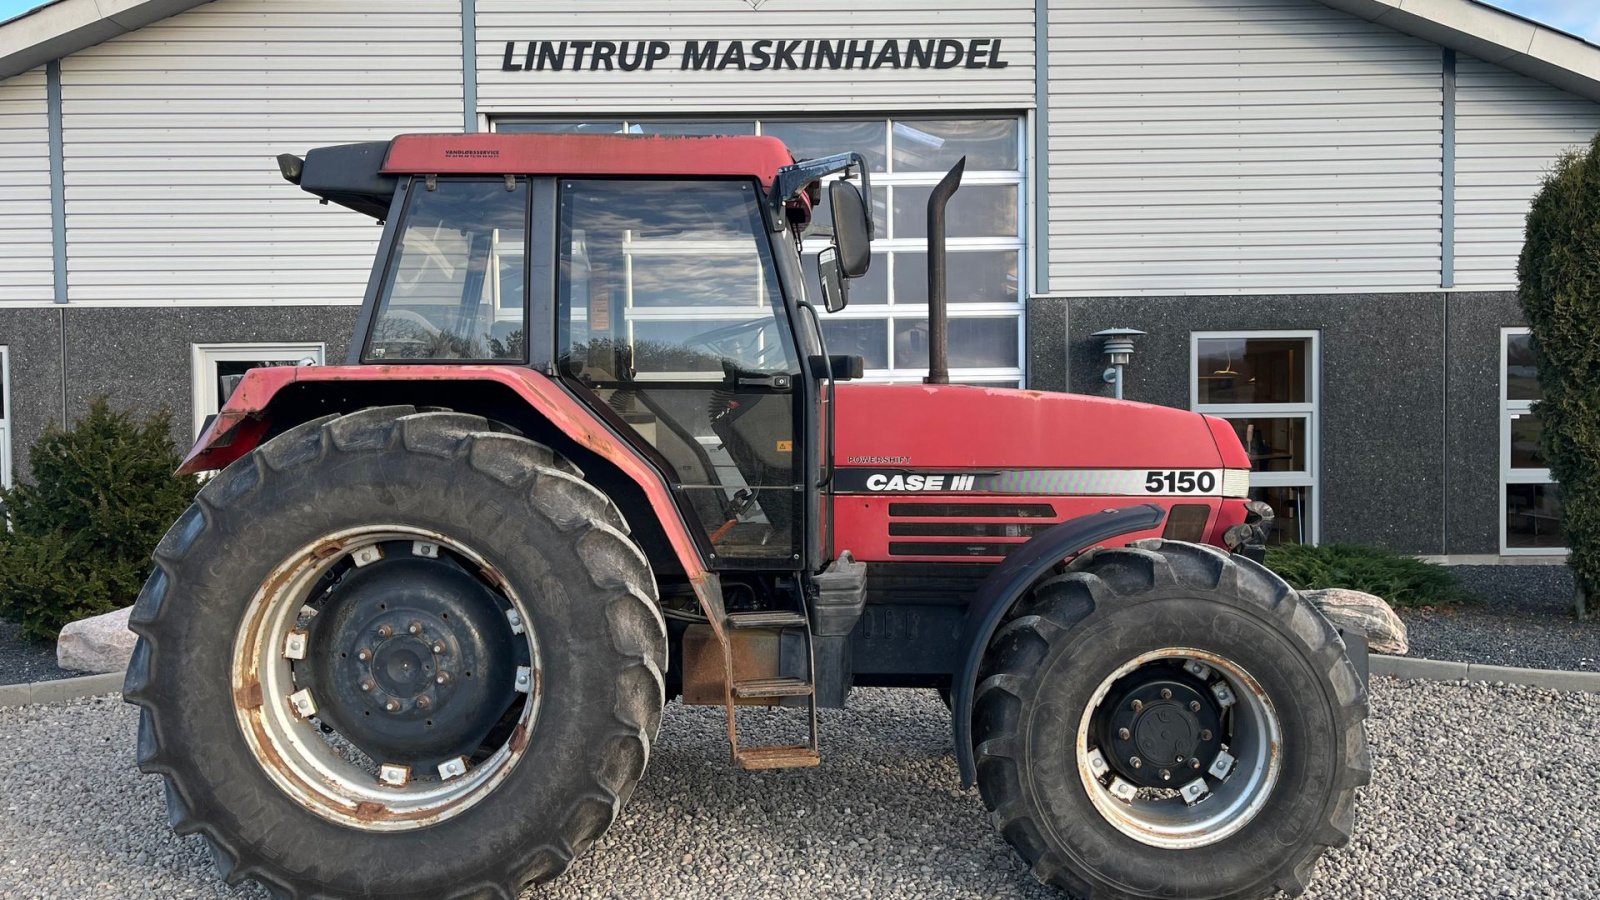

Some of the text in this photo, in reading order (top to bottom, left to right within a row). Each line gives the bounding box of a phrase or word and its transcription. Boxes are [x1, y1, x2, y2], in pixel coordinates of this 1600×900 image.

[502, 39, 1009, 72] LINTRUP MASKINHANDEL
[848, 456, 911, 464] POWERSHIFT
[866, 474, 944, 491] CASE
[1145, 471, 1215, 493] 5150
